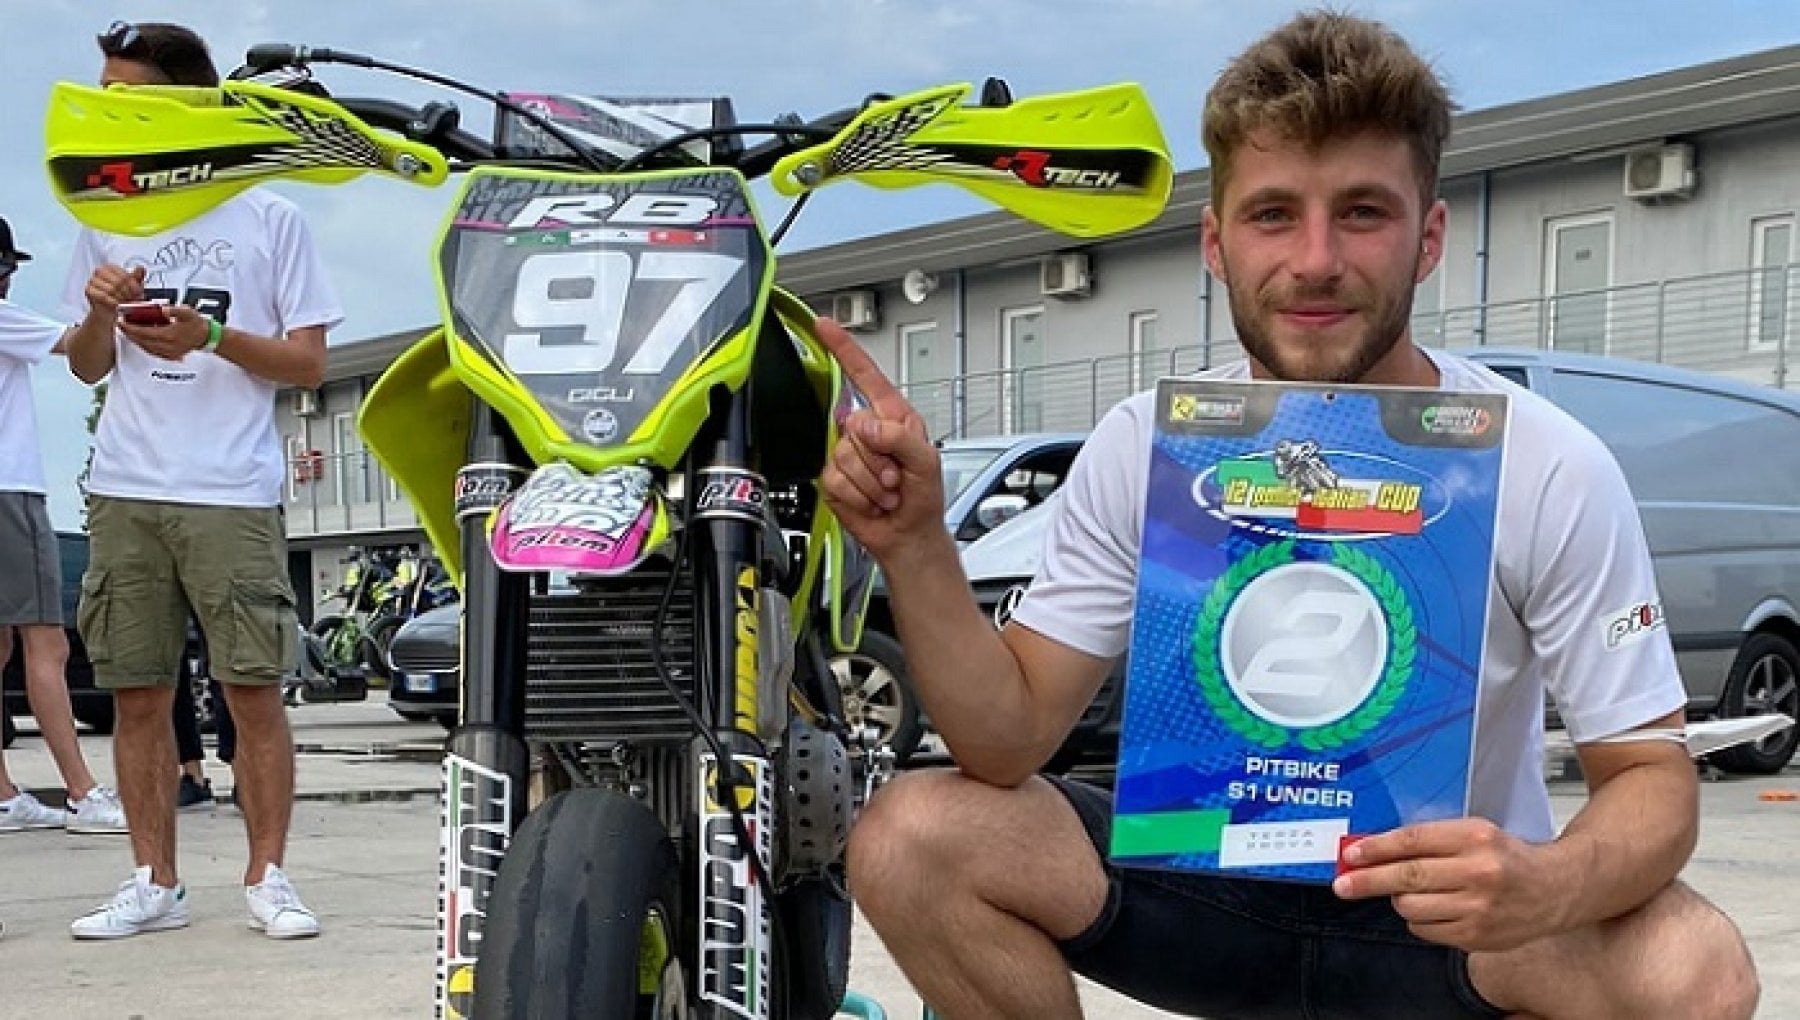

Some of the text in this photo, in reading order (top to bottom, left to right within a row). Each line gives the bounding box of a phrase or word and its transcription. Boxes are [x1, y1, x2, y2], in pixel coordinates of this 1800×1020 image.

[508, 194, 718, 227] RB
[504, 251, 745, 374] 97
[1241, 590, 1372, 697] 2
[1246, 757, 1341, 781] PITBIKE
[1228, 782, 1353, 808] S1 UNDER
